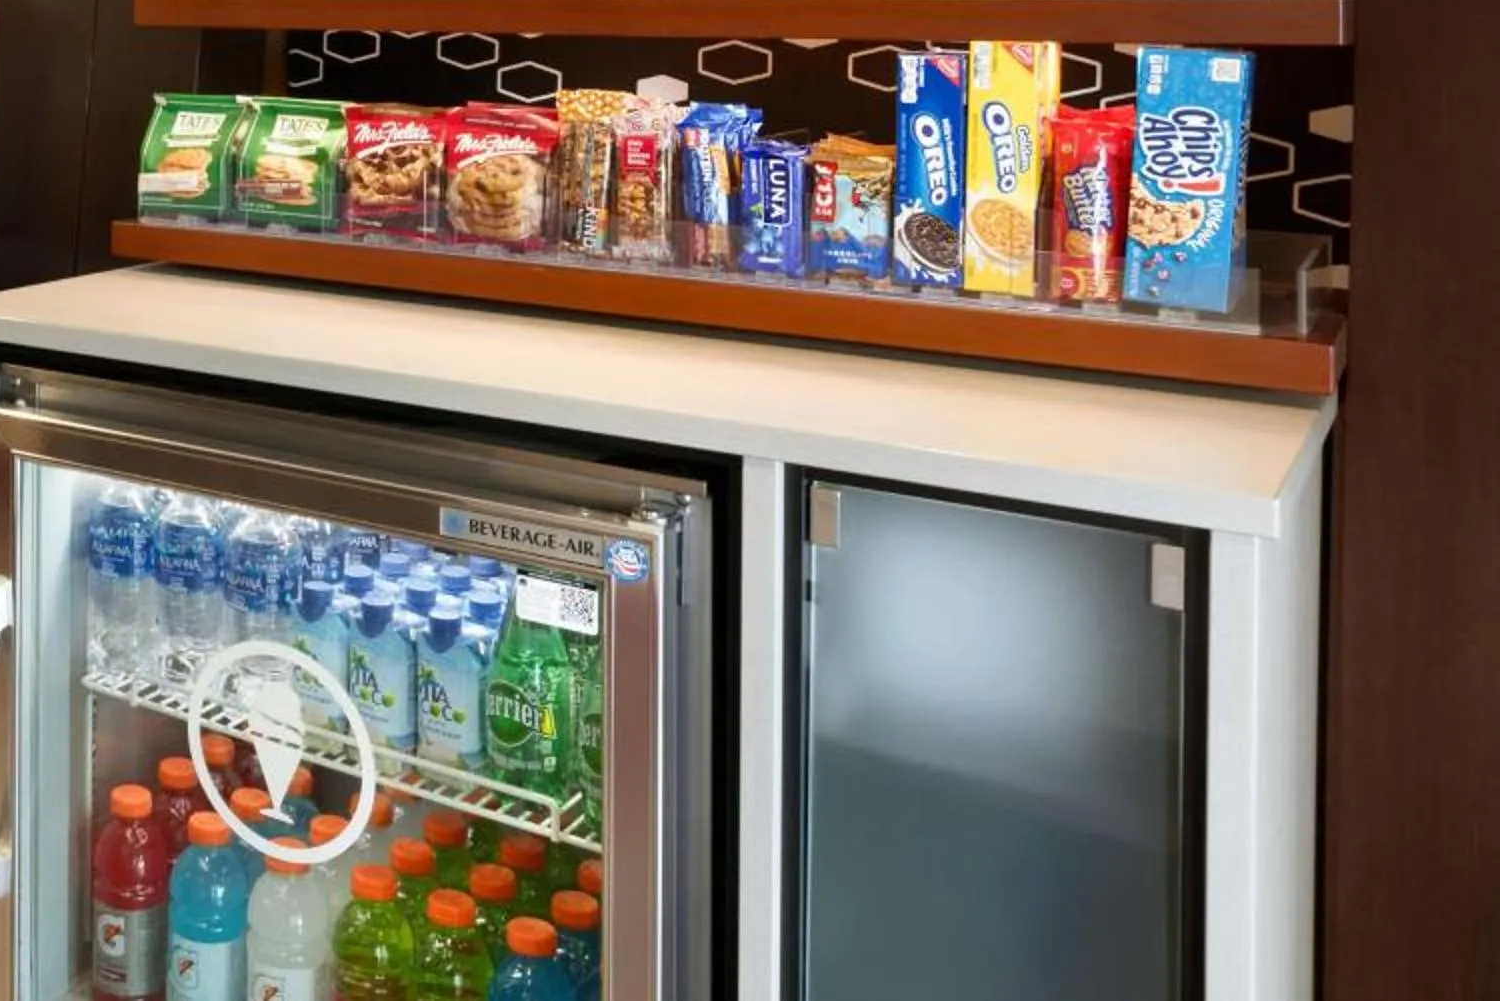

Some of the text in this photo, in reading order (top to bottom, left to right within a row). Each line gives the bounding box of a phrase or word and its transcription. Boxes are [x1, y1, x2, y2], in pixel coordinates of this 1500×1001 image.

[913, 114, 948, 206] OREO
[984, 102, 1016, 193] OREO
[1171, 107, 1221, 178] Chips
[769, 158, 787, 219] LUNA
[468, 518, 596, 556] BEVERAGE-AIR
